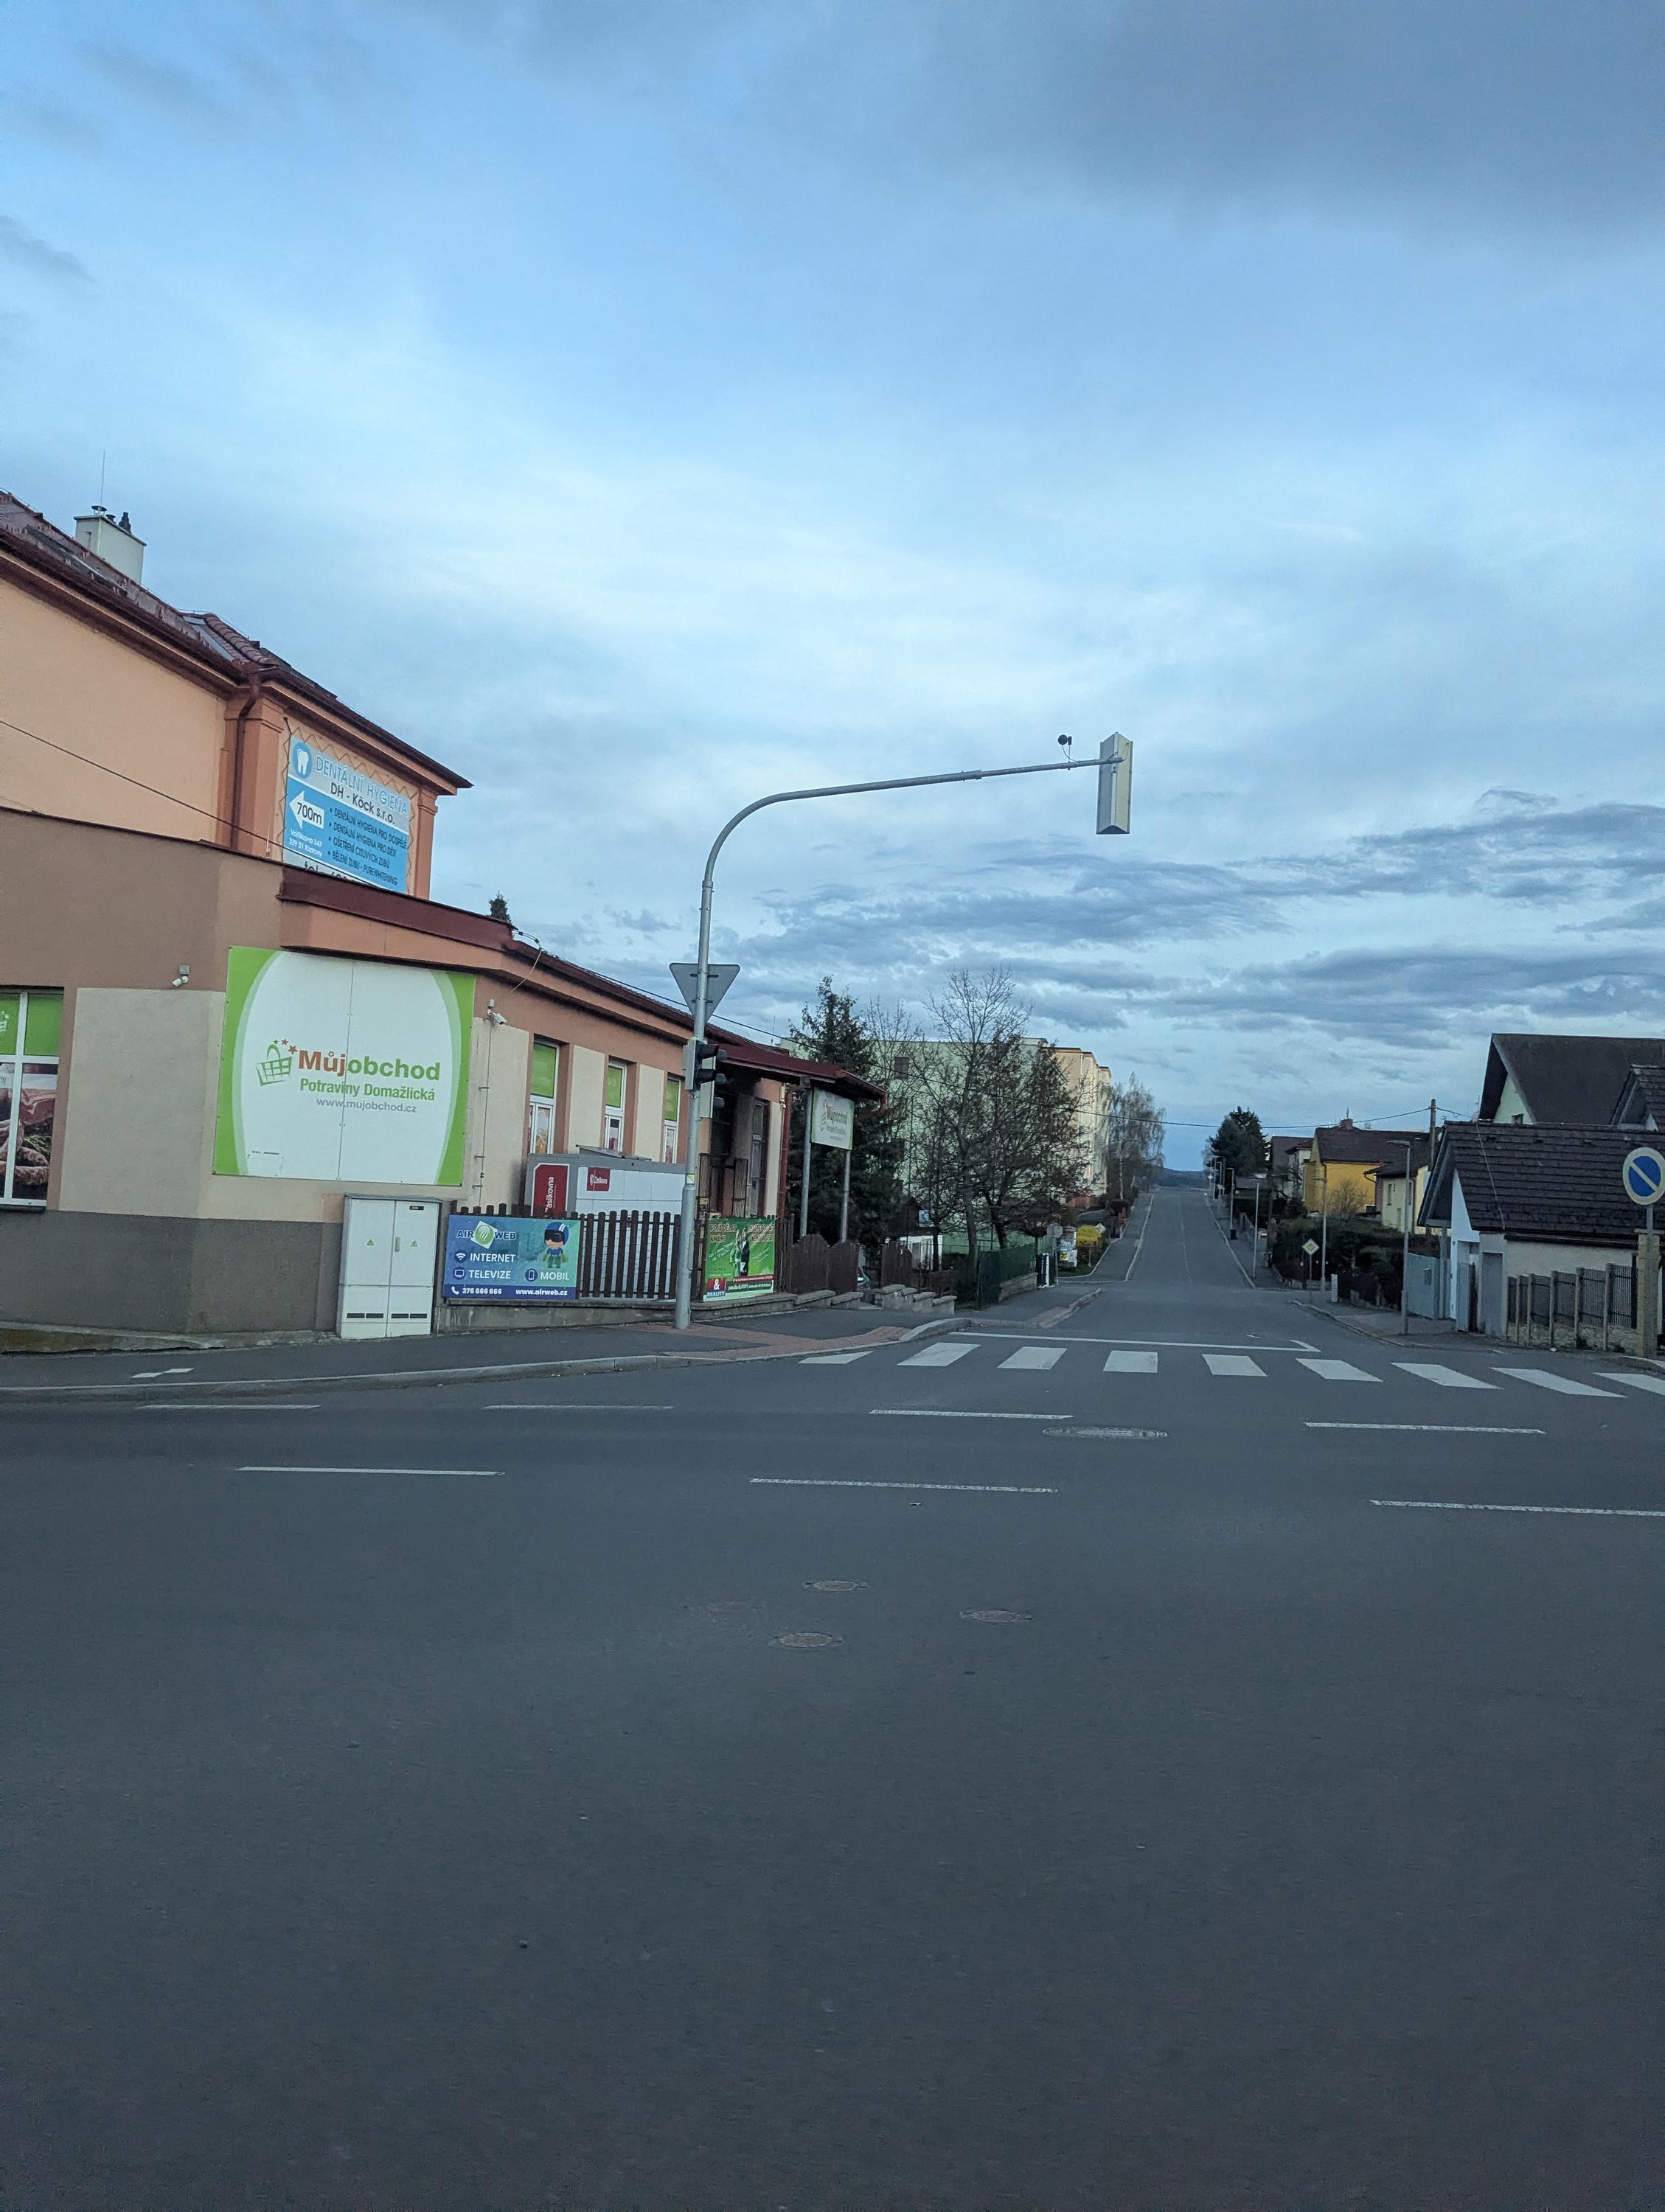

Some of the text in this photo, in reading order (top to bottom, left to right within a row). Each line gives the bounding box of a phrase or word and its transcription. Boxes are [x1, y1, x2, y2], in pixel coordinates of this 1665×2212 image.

[316, 754, 407, 813] DENTÁLNÍ HYGIENA
[331, 782, 344, 799] DH
[352, 793, 375, 814] Köck
[376, 807, 395, 824] s.r.o.
[296, 802, 322, 825] 700m
[378, 829, 388, 840] PRO
[377, 843, 386, 853] PRO
[298, 1050, 441, 1081] Můjobchod
[300, 1078, 435, 1102] Potraviny Domažlická
[316, 1098, 417, 1113] www.mujobchod.cz
[456, 1230, 516, 1239] AIR WEB
[470, 1253, 516, 1262] INTERNET
[469, 1270, 511, 1279] TELEVIZE
[540, 1272, 569, 1280] MOBIL
